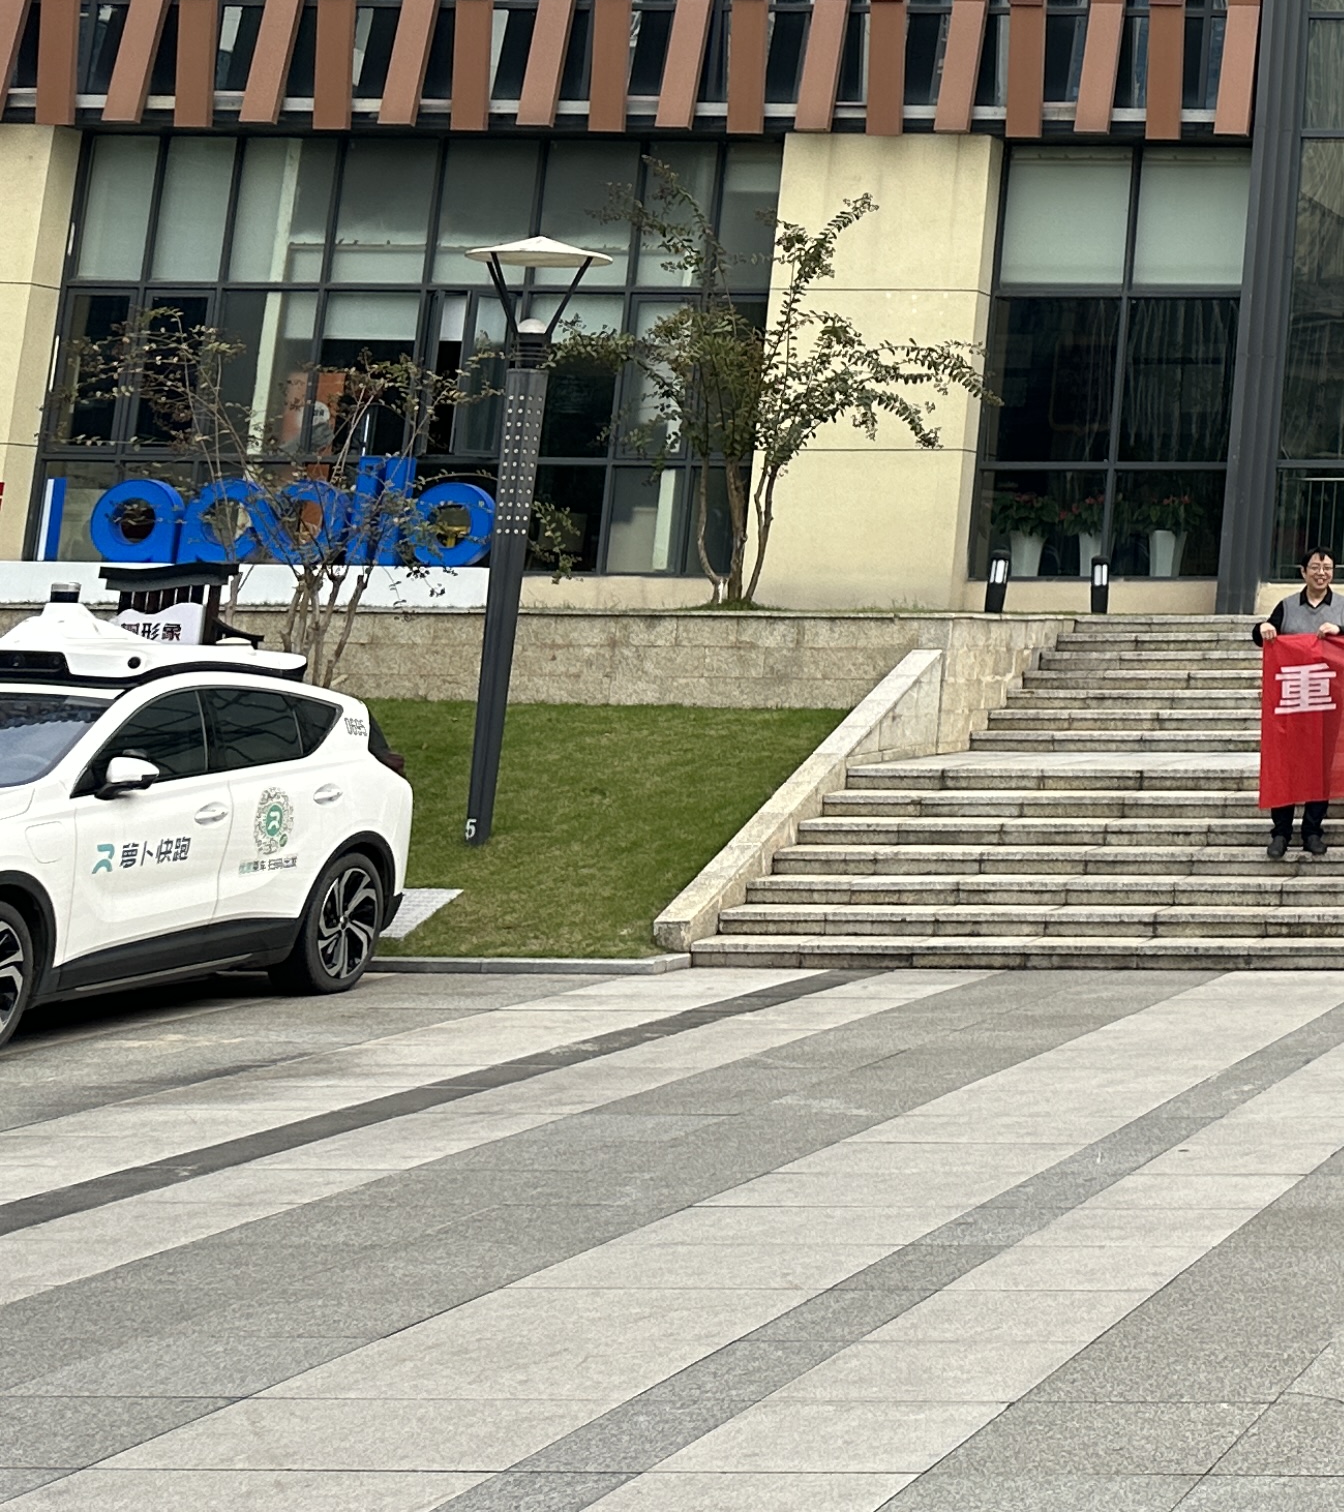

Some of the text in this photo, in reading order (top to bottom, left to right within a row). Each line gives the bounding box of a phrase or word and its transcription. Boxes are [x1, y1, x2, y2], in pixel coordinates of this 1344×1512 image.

[465, 818, 477, 840] 5
[119, 836, 192, 869] 萝卜快跑
